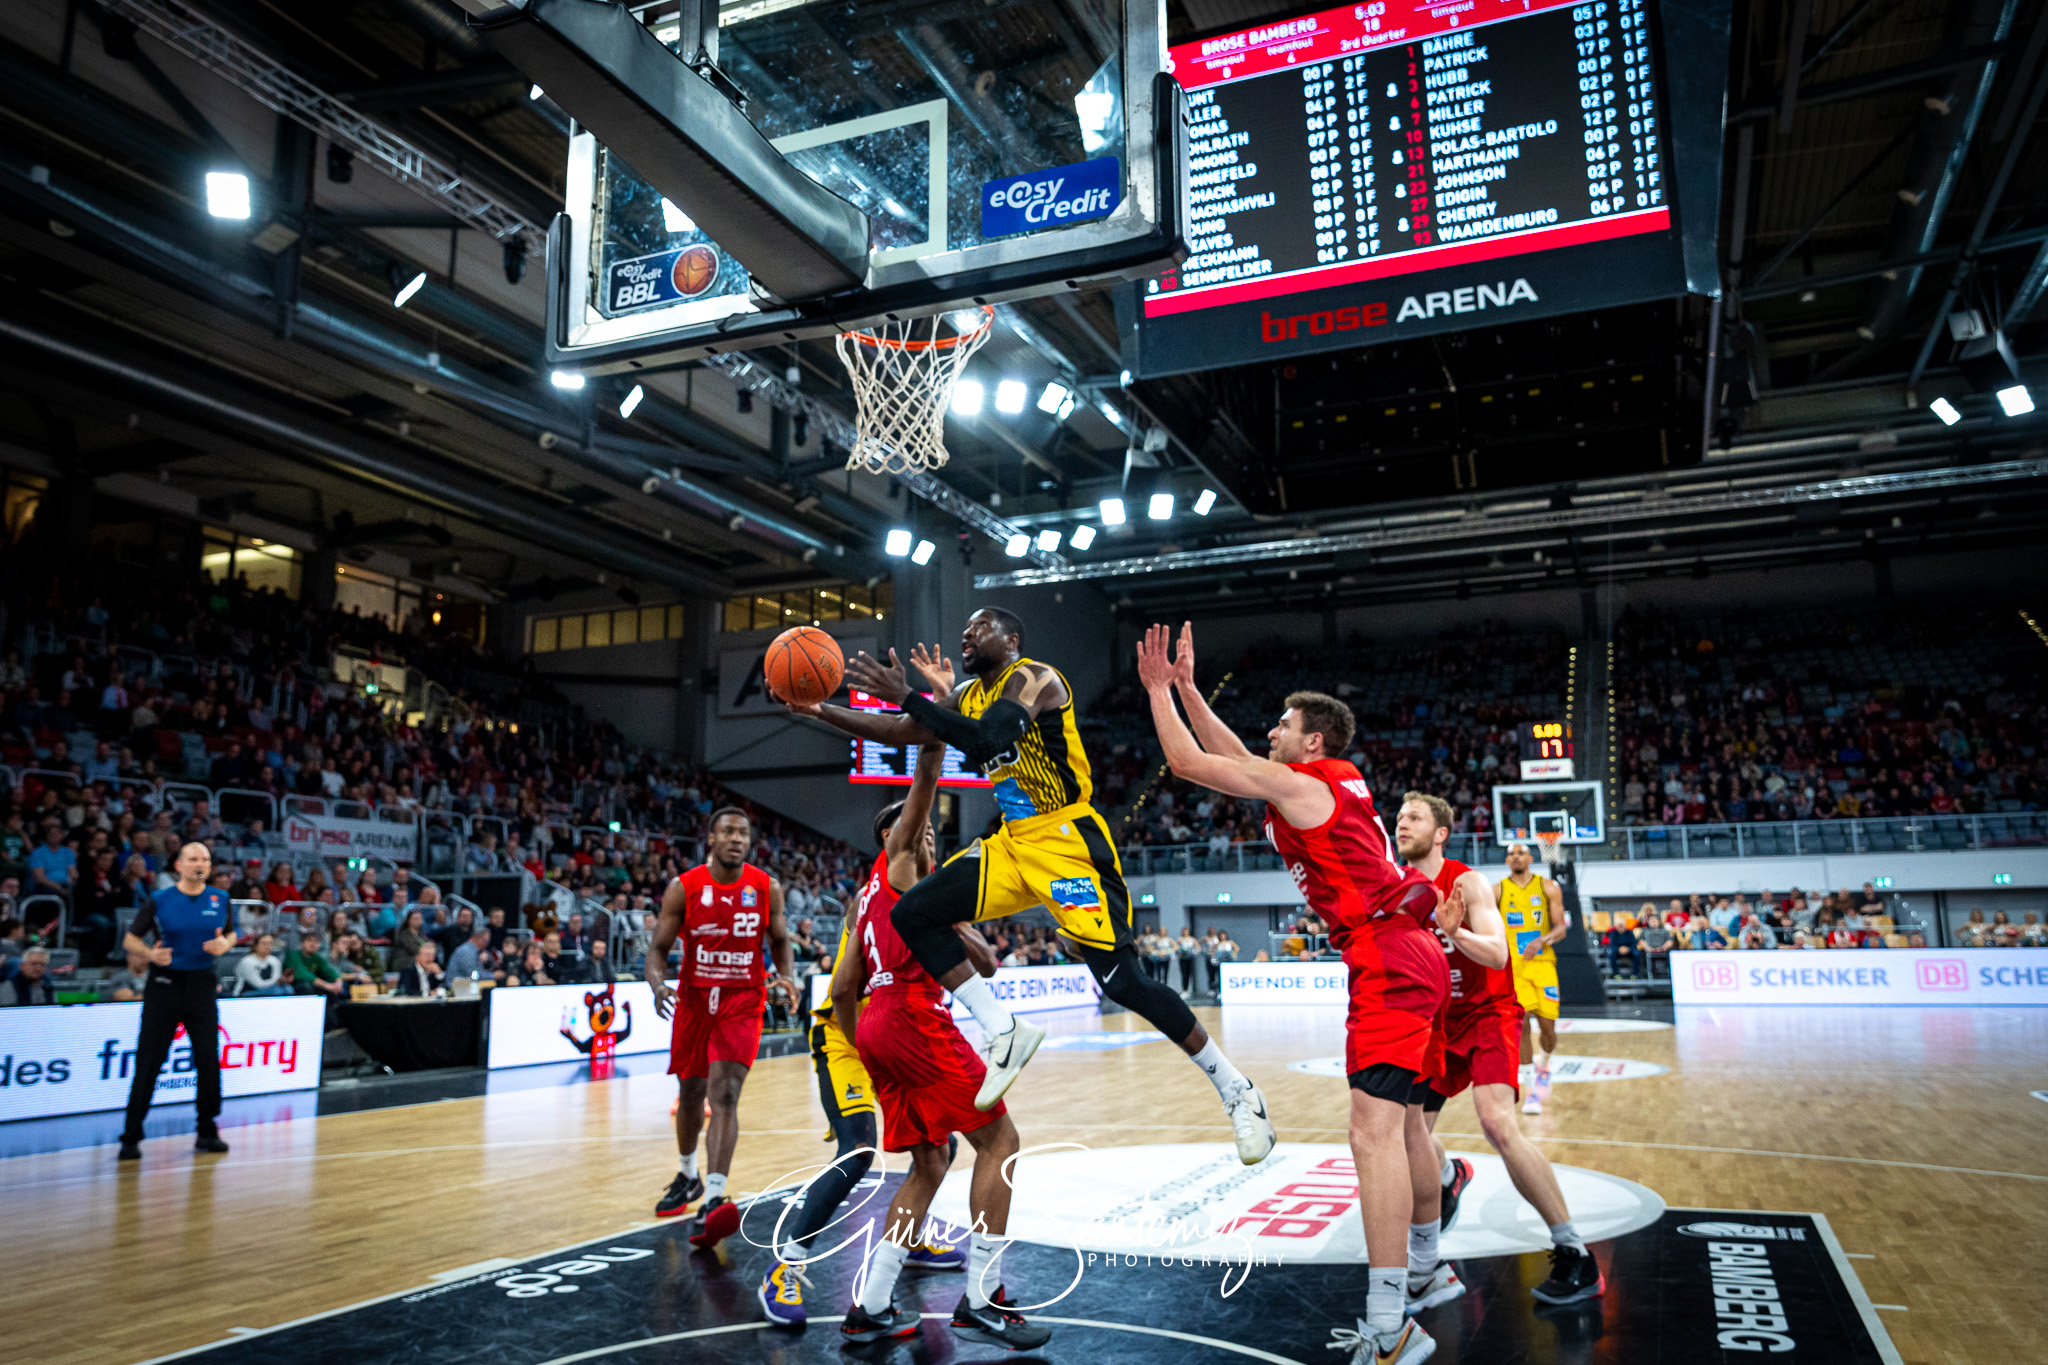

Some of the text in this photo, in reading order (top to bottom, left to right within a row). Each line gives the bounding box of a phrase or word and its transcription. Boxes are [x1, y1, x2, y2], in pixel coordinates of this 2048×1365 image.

[1201, 18, 1317, 56] BROSE BAMBERG
[1361, 28, 1407, 45] Quarter
[1423, 32, 1473, 55] BÄHRE
[1573, 5, 1592, 21] 05
[1595, 3, 1606, 17] P
[1424, 46, 1488, 72] PATRICK
[1575, 23, 1594, 39] 03
[1597, 20, 1608, 34] P
[1425, 68, 1468, 89] HUBB
[1577, 40, 1595, 56] 17
[1599, 38, 1610, 52] P
[1427, 80, 1491, 106] PATRICK
[1578, 58, 1597, 74] 00
[1600, 55, 1611, 69] P
[1188, 89, 1215, 104] UNT
[1189, 105, 1221, 122] LLER
[1304, 82, 1322, 98] 07
[1428, 99, 1484, 123] MILLER
[1579, 76, 1599, 91] 02
[1602, 73, 1613, 87] P
[1429, 117, 1481, 140] KUHSE
[1581, 93, 1600, 109] 02
[1603, 90, 1615, 105] P
[1189, 120, 1229, 137] OMAS
[1189, 131, 1249, 154] OHLRATH
[1431, 120, 1557, 157] POLAS-BARTOLO
[1583, 111, 1602, 126] 12
[1605, 108, 1616, 122] P
[1189, 150, 1238, 171] MMONS
[1308, 131, 1326, 147] 07
[1328, 129, 1339, 143] P
[1189, 163, 1257, 186] NNEFELD
[1329, 146, 1340, 160] P
[1432, 144, 1519, 174] HARTMANN
[1584, 128, 1604, 144] 00
[1606, 125, 1618, 140] P
[1434, 164, 1506, 191] JOHNSON
[1586, 146, 1606, 162] 06
[1608, 143, 1620, 158] P
[1330, 162, 1341, 177] P
[1332, 179, 1343, 193] P
[1587, 163, 1607, 179] 02
[1610, 161, 1621, 175] P
[1025, 187, 1111, 223] Credit
[1190, 218, 1226, 236] OUNG
[1333, 196, 1344, 210] P
[1437, 201, 1497, 225] CHERRY
[1589, 181, 1609, 197] 06
[1611, 179, 1623, 193] P
[1437, 208, 1558, 242] WAARDENBURG
[1591, 199, 1611, 215] 06
[1613, 196, 1625, 211] P
[1191, 233, 1233, 253] EAVES
[1334, 212, 1346, 226] P
[1336, 229, 1347, 243] P
[1337, 246, 1348, 260] P
[615, 281, 661, 308] BBL
[1261, 278, 1539, 343] brose ARENA
[1541, 739, 1563, 758] 17
[732, 912, 761, 937] 22
[1532, 909, 1543, 926] 7
[696, 944, 755, 966] brose
[1051, 976, 1086, 995] PFAND
[1228, 976, 1345, 989] SPENDE DEI
[1699, 965, 1734, 986] DB
[1750, 967, 1889, 987] SCHENKER
[1922, 963, 1963, 985] DB
[1708, 1242, 1796, 1352] BAMBERG
